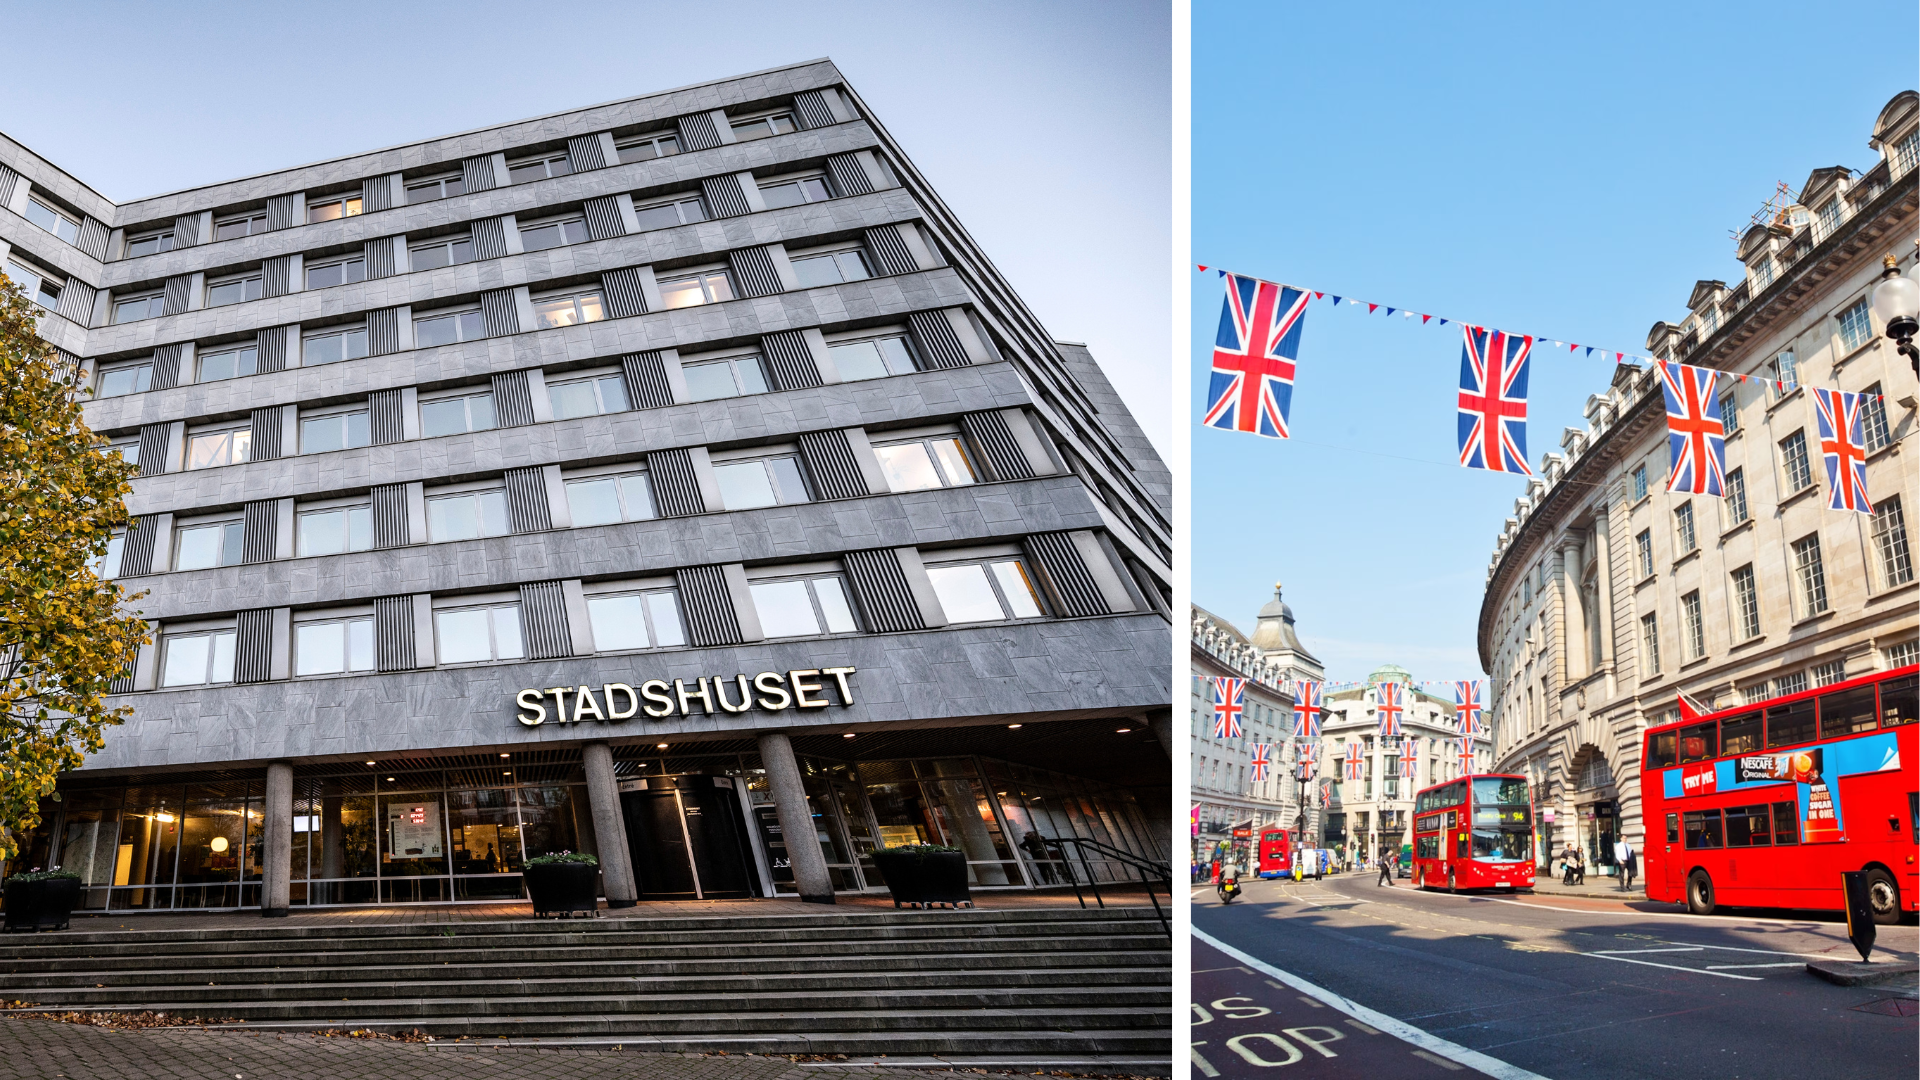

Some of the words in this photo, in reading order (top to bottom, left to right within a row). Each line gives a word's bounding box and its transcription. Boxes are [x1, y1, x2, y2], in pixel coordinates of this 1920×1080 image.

[516, 666, 856, 726] STADSHUSET
[1741, 756, 1774, 769] NESCAFÉ
[1684, 774, 1700, 789] TRY
[1702, 770, 1714, 785] ME
[1810, 784, 1827, 792] WHITE
[1810, 792, 1830, 801] COFFEE
[1809, 800, 1832, 810] SUGAR
[1512, 812, 1524, 821] 94
[1808, 811, 1818, 820] IN
[1818, 809, 1834, 819] ONE
